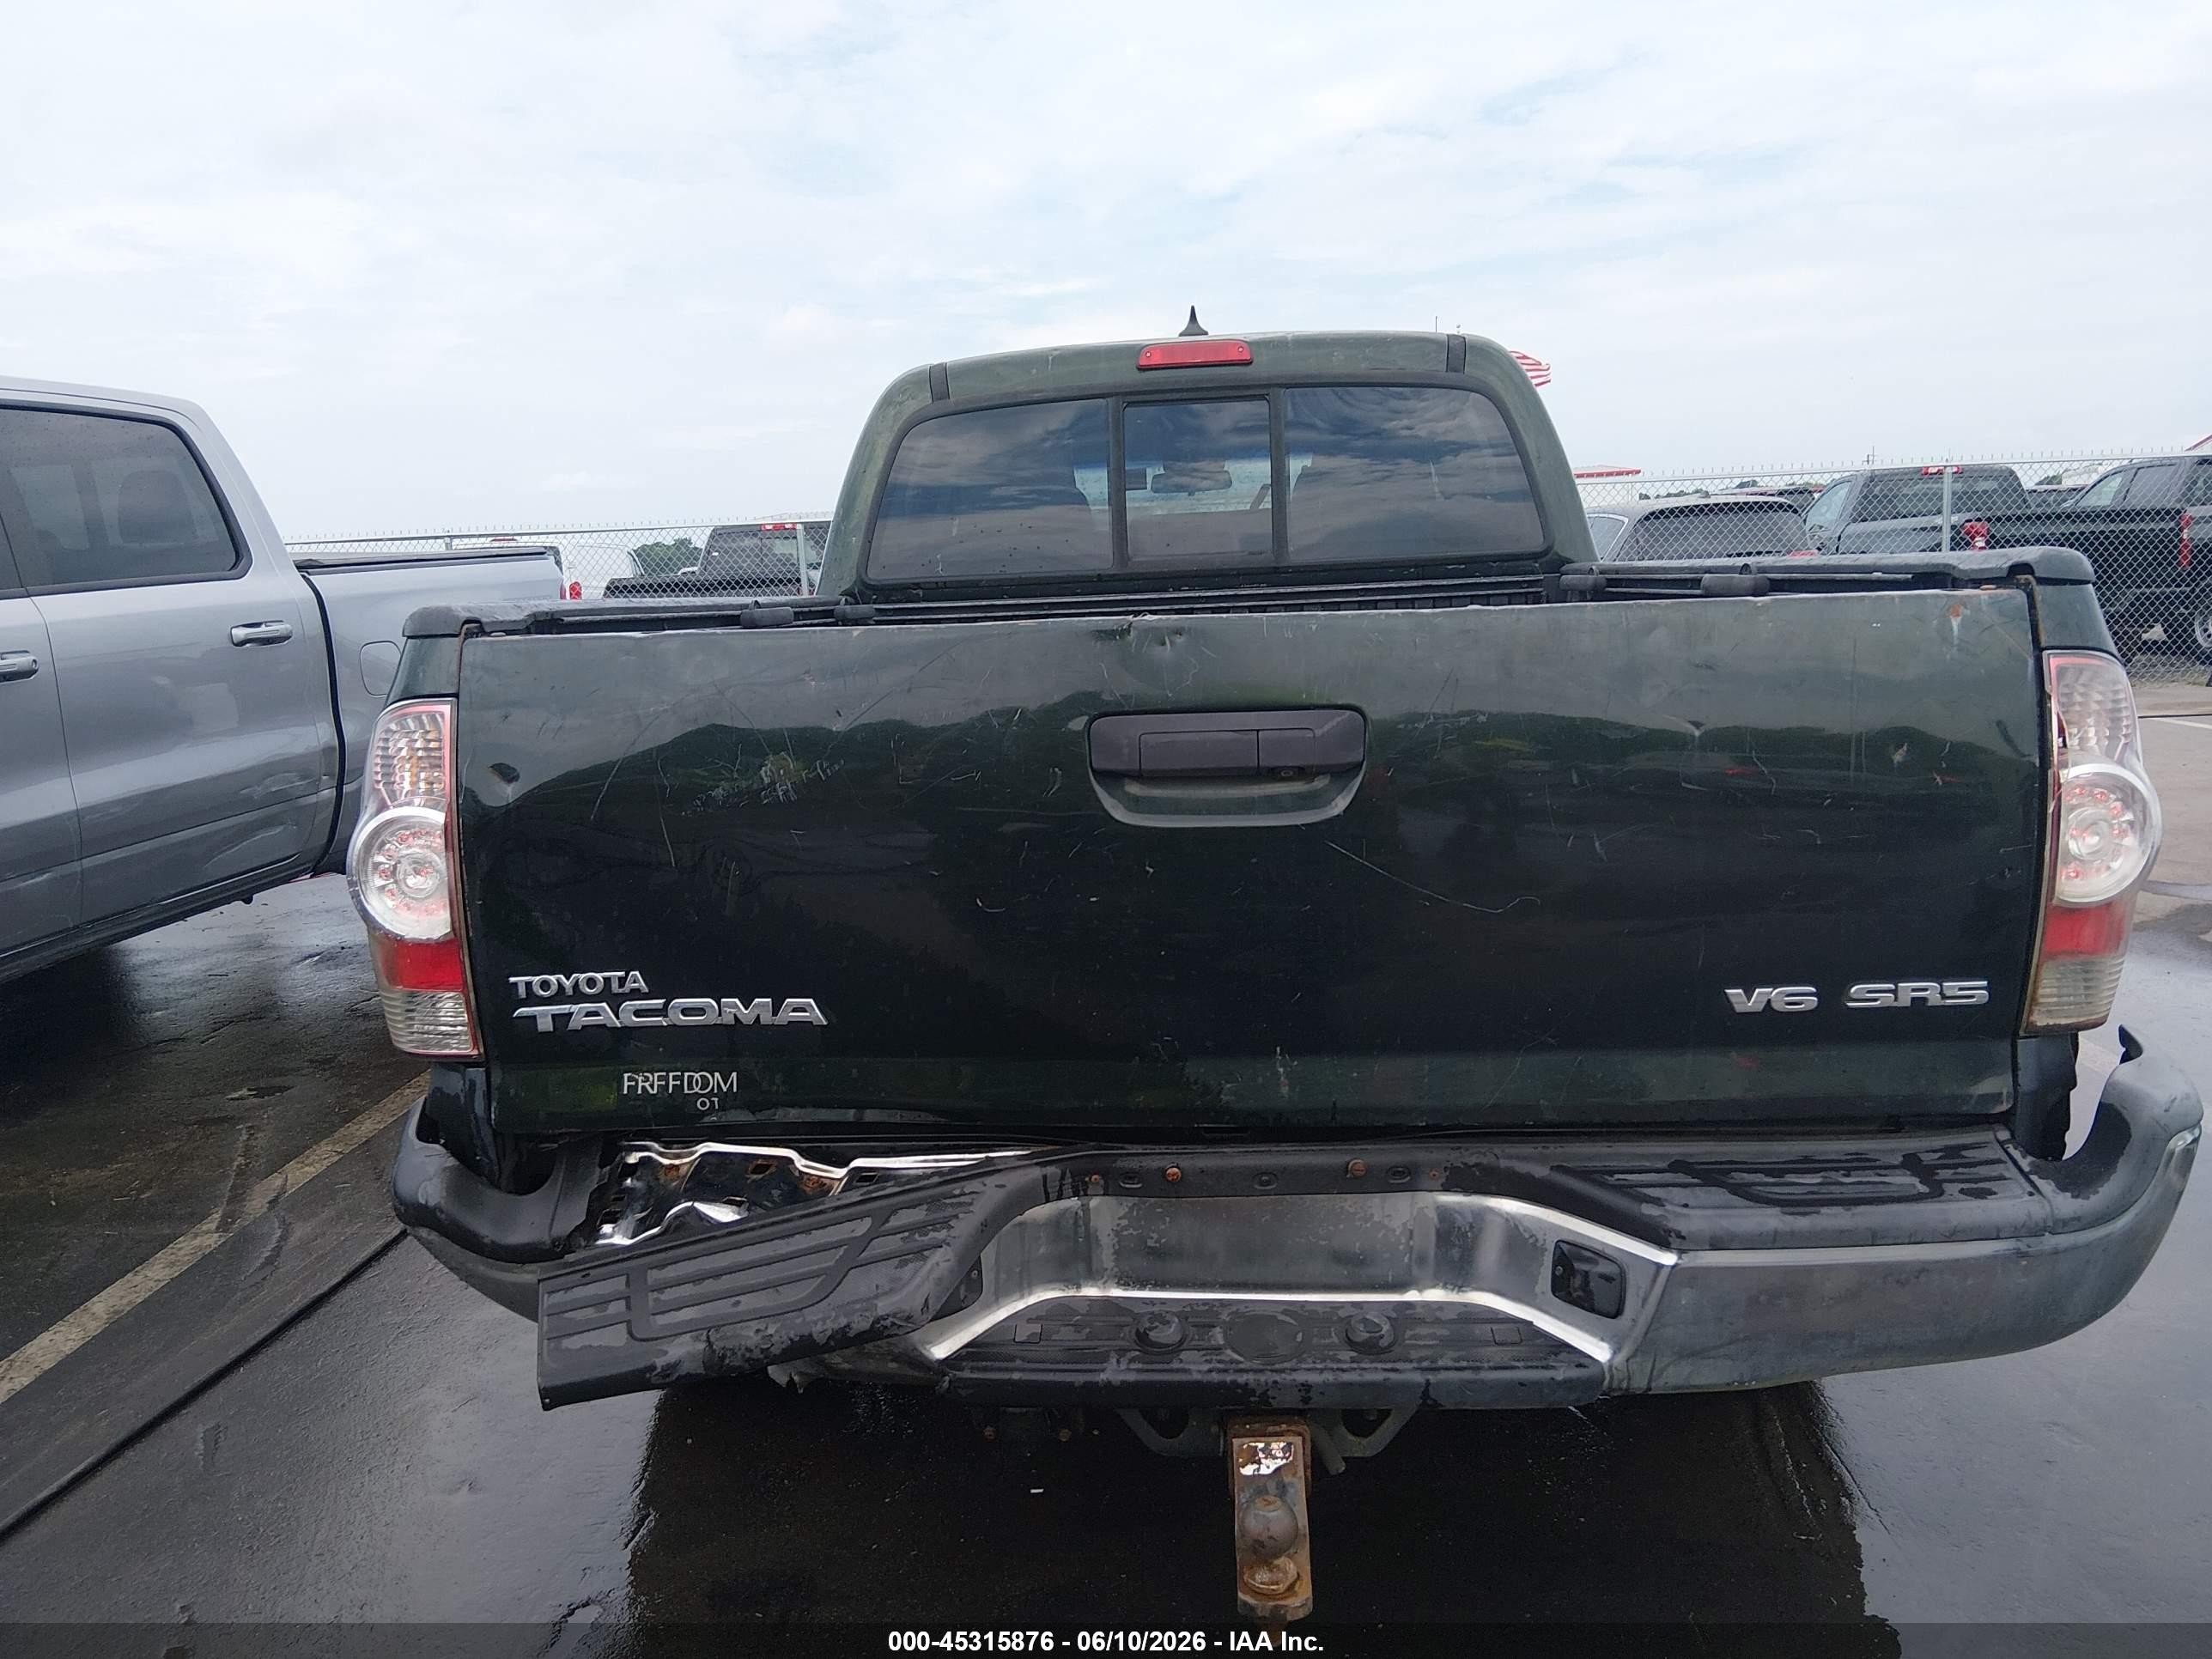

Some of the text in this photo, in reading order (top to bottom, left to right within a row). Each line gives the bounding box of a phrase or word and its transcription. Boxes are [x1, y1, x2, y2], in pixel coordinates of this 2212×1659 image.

[508, 970, 649, 999] TOYOTA
[1724, 981, 1989, 1012] V6 SR5
[513, 998, 829, 1033] TACOMA
